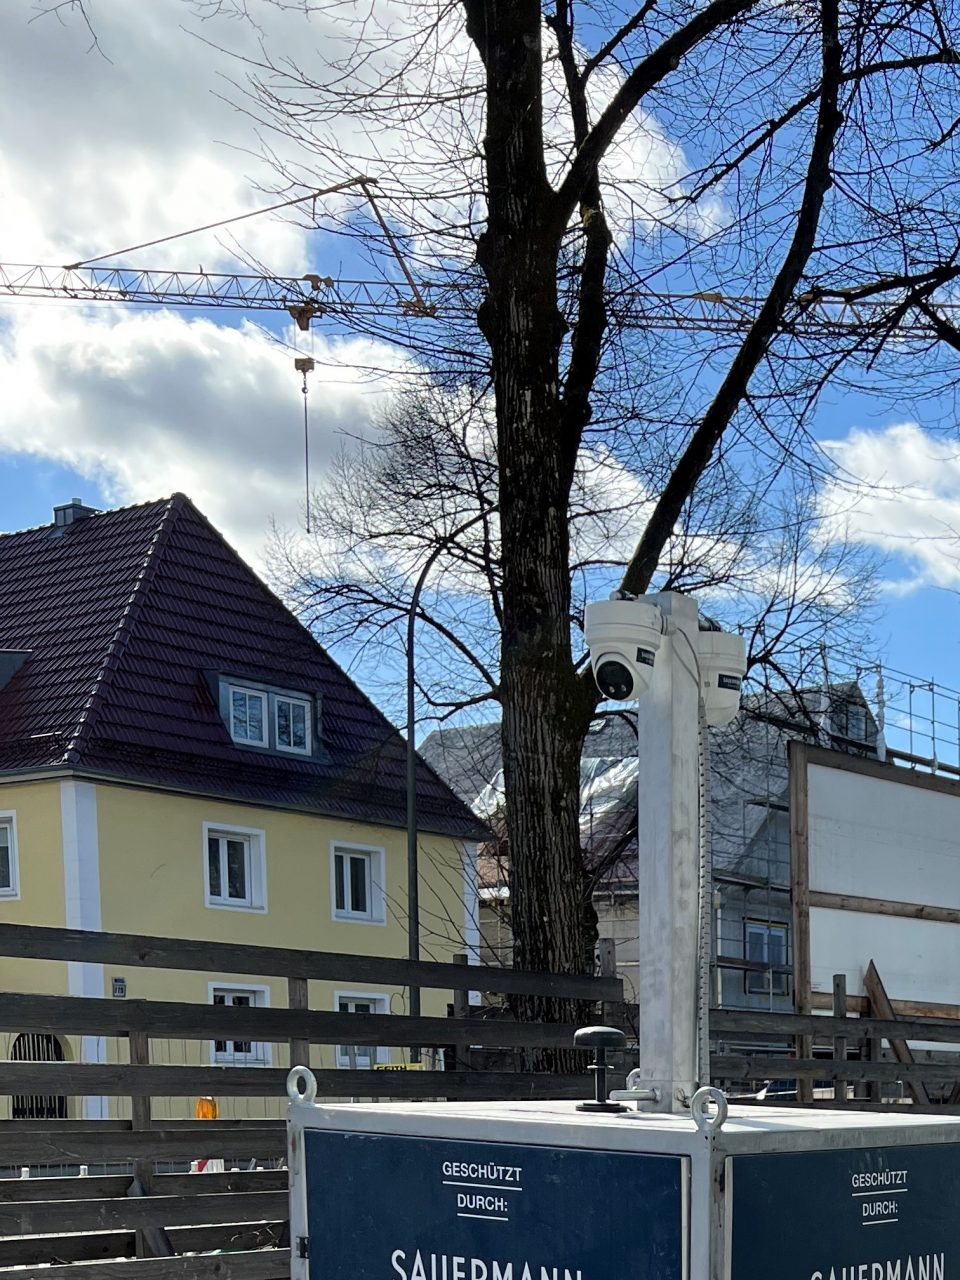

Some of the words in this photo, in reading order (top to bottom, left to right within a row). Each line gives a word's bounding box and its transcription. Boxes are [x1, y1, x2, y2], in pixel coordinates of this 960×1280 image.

[442, 1161, 523, 1182] GESCHÜTZT
[851, 1168, 908, 1189] GESCHÜTZT
[457, 1193, 509, 1212] DURCH:
[862, 1201, 898, 1217] DURCH:
